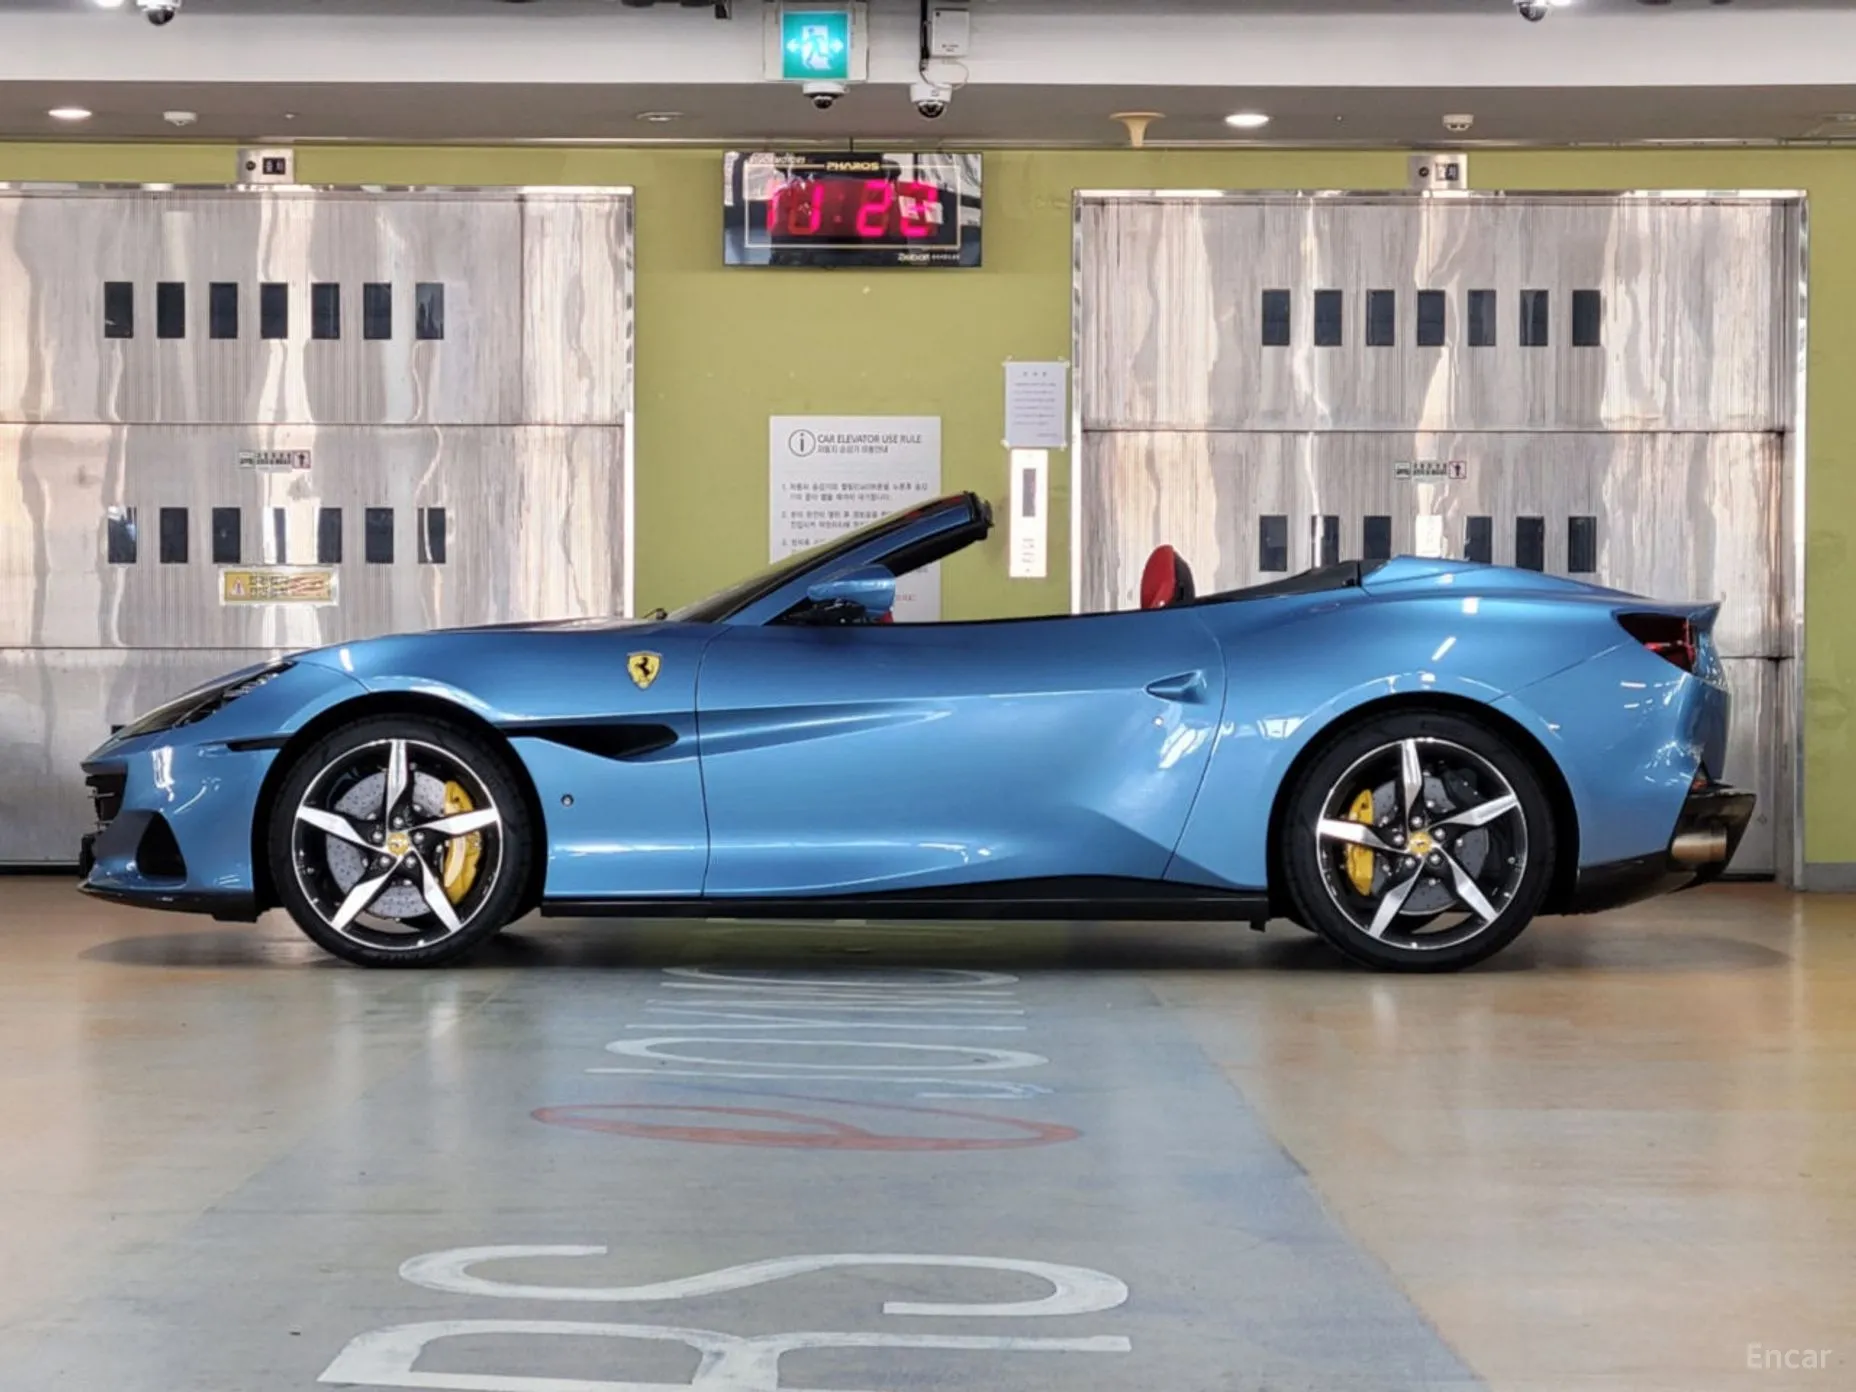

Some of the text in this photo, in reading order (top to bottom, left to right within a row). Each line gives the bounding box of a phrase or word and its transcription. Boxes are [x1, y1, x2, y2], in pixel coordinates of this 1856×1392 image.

[826, 161, 880, 172] PHAROS
[817, 433, 922, 444] CAR ELEVATOR USE RULE
